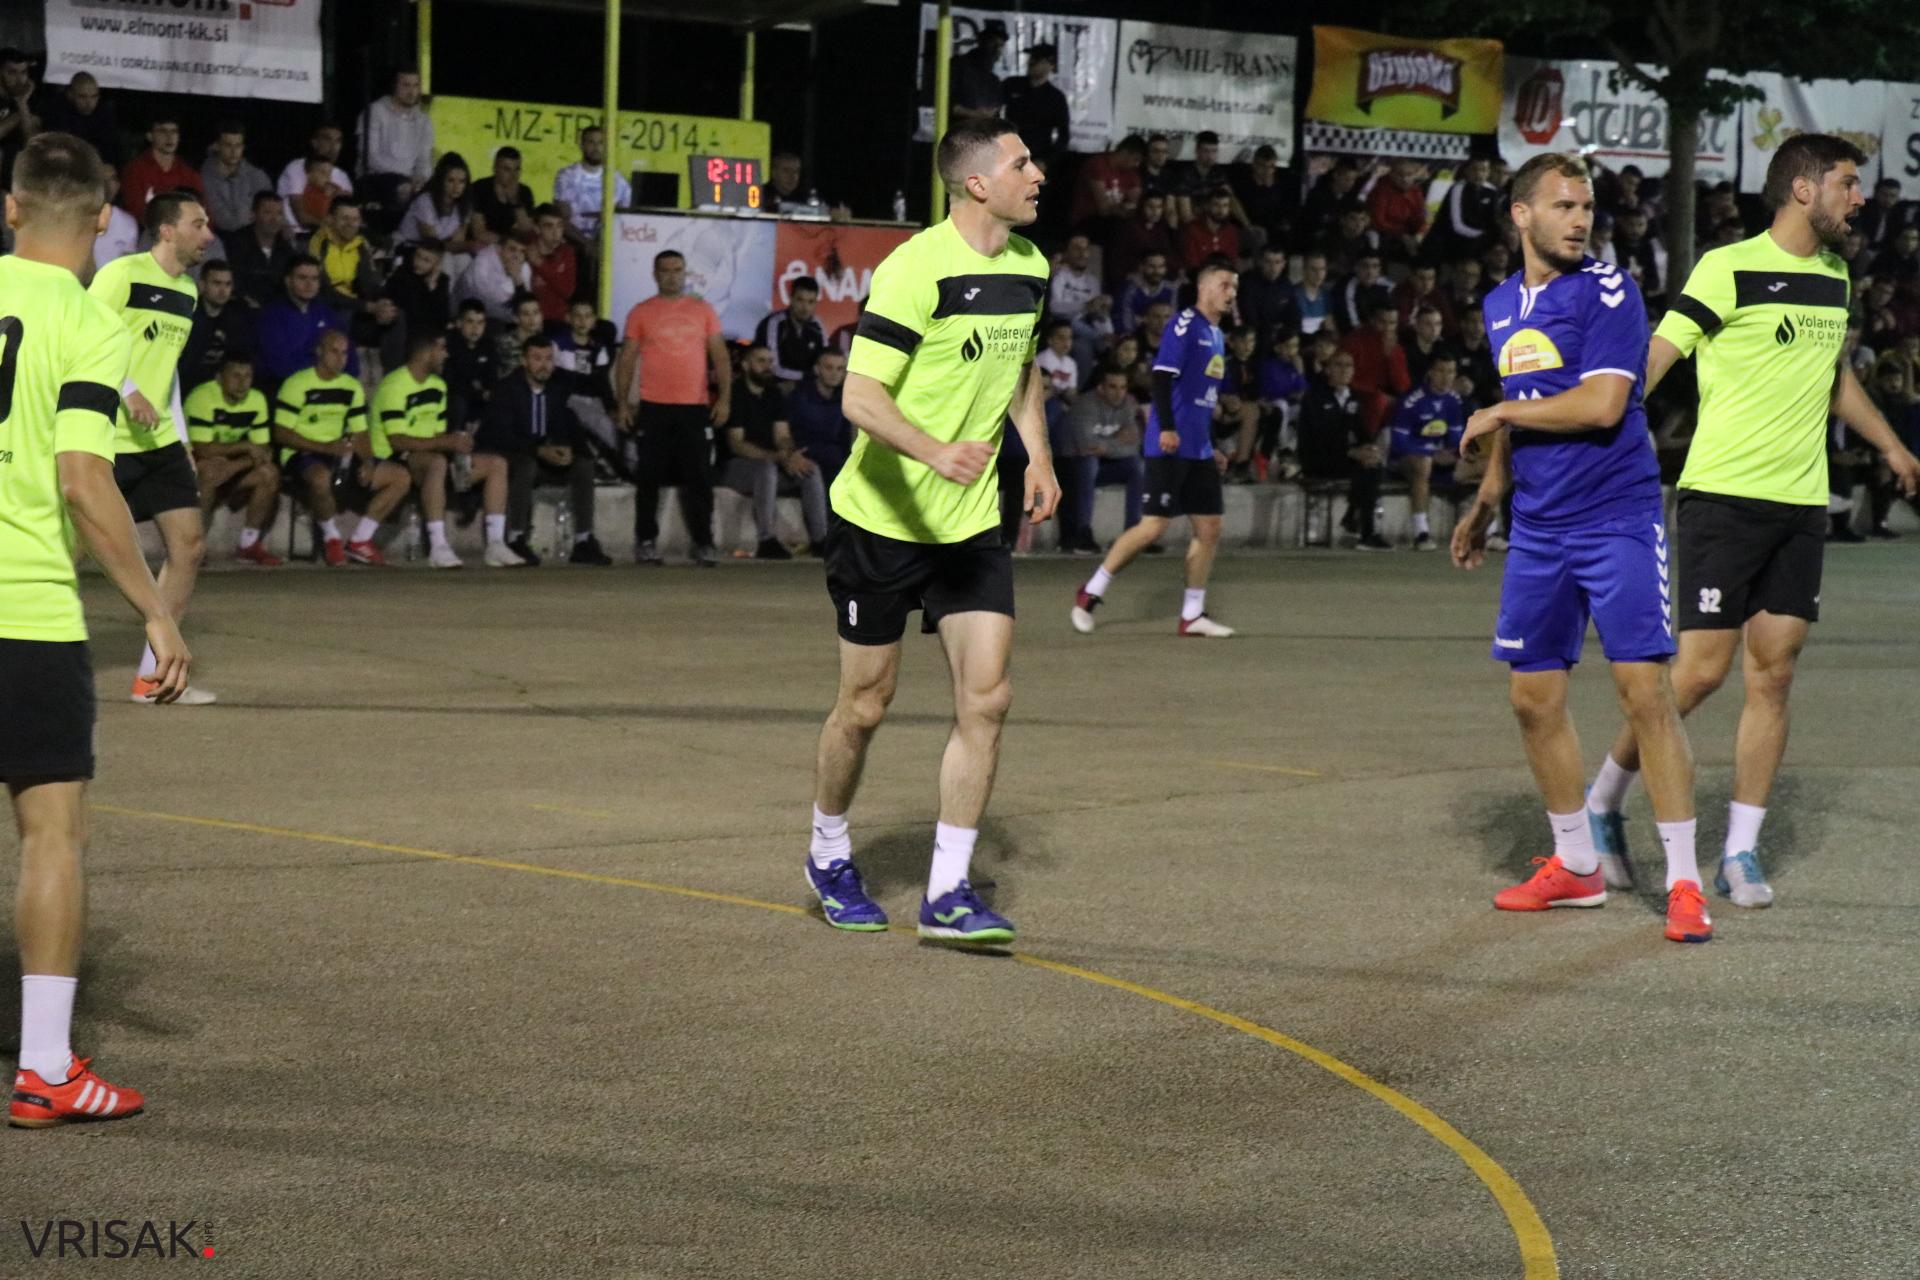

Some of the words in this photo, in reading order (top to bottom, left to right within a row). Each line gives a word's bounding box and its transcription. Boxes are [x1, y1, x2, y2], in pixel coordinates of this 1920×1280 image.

[714, 183, 721, 203] 1
[748, 185, 760, 208] 0
[848, 600, 858, 627] 9
[1698, 587, 1722, 614] 32
